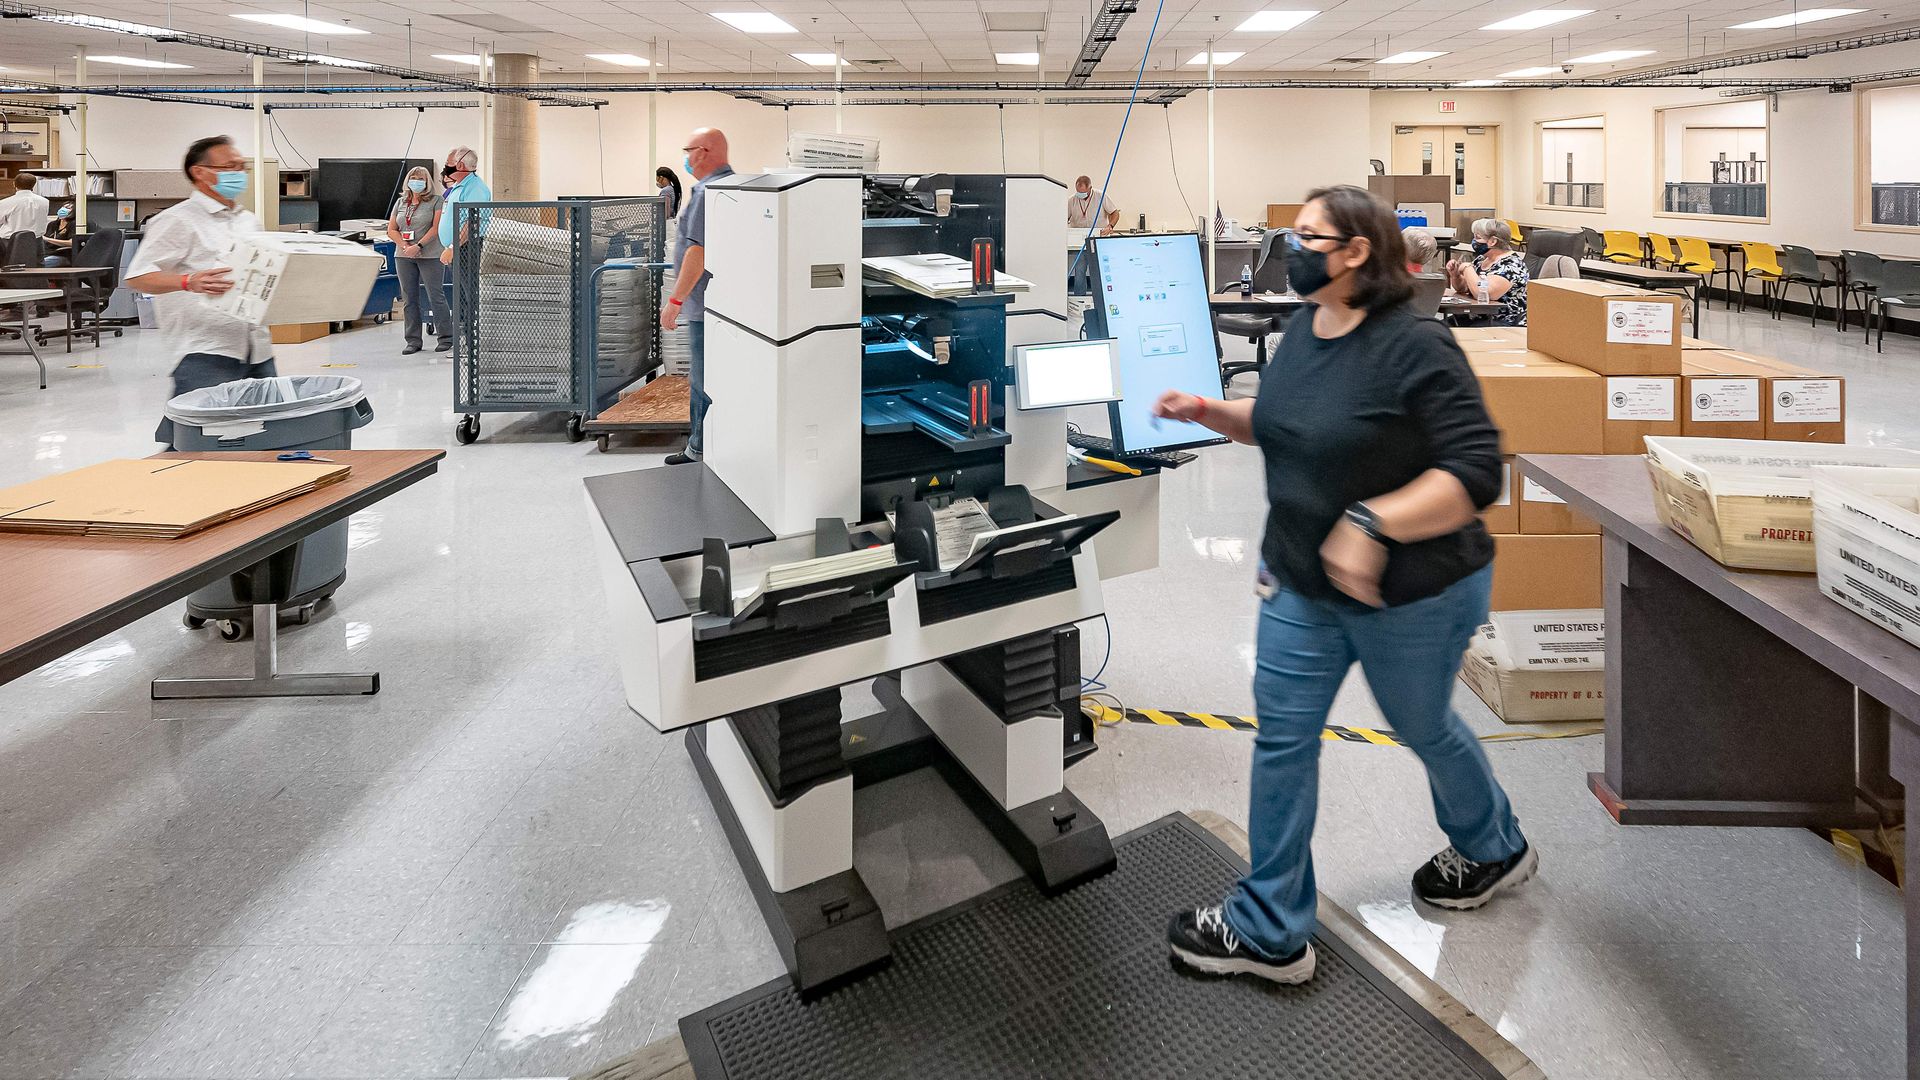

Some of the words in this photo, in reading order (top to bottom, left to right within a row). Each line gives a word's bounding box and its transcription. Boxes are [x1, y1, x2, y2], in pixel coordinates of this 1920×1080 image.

[1442, 101, 1455, 111] EXIT
[1761, 527, 1813, 542] PROPERT
[1839, 548, 1875, 574] UNITED
[1877, 567, 1919, 597] STATES
[1846, 595, 1865, 610] TRAY
[1533, 624, 1566, 633] UNITED
[1567, 623, 1599, 632] STATES
[1530, 691, 1569, 700] PROPERTY
[1572, 691, 1582, 700] OF
